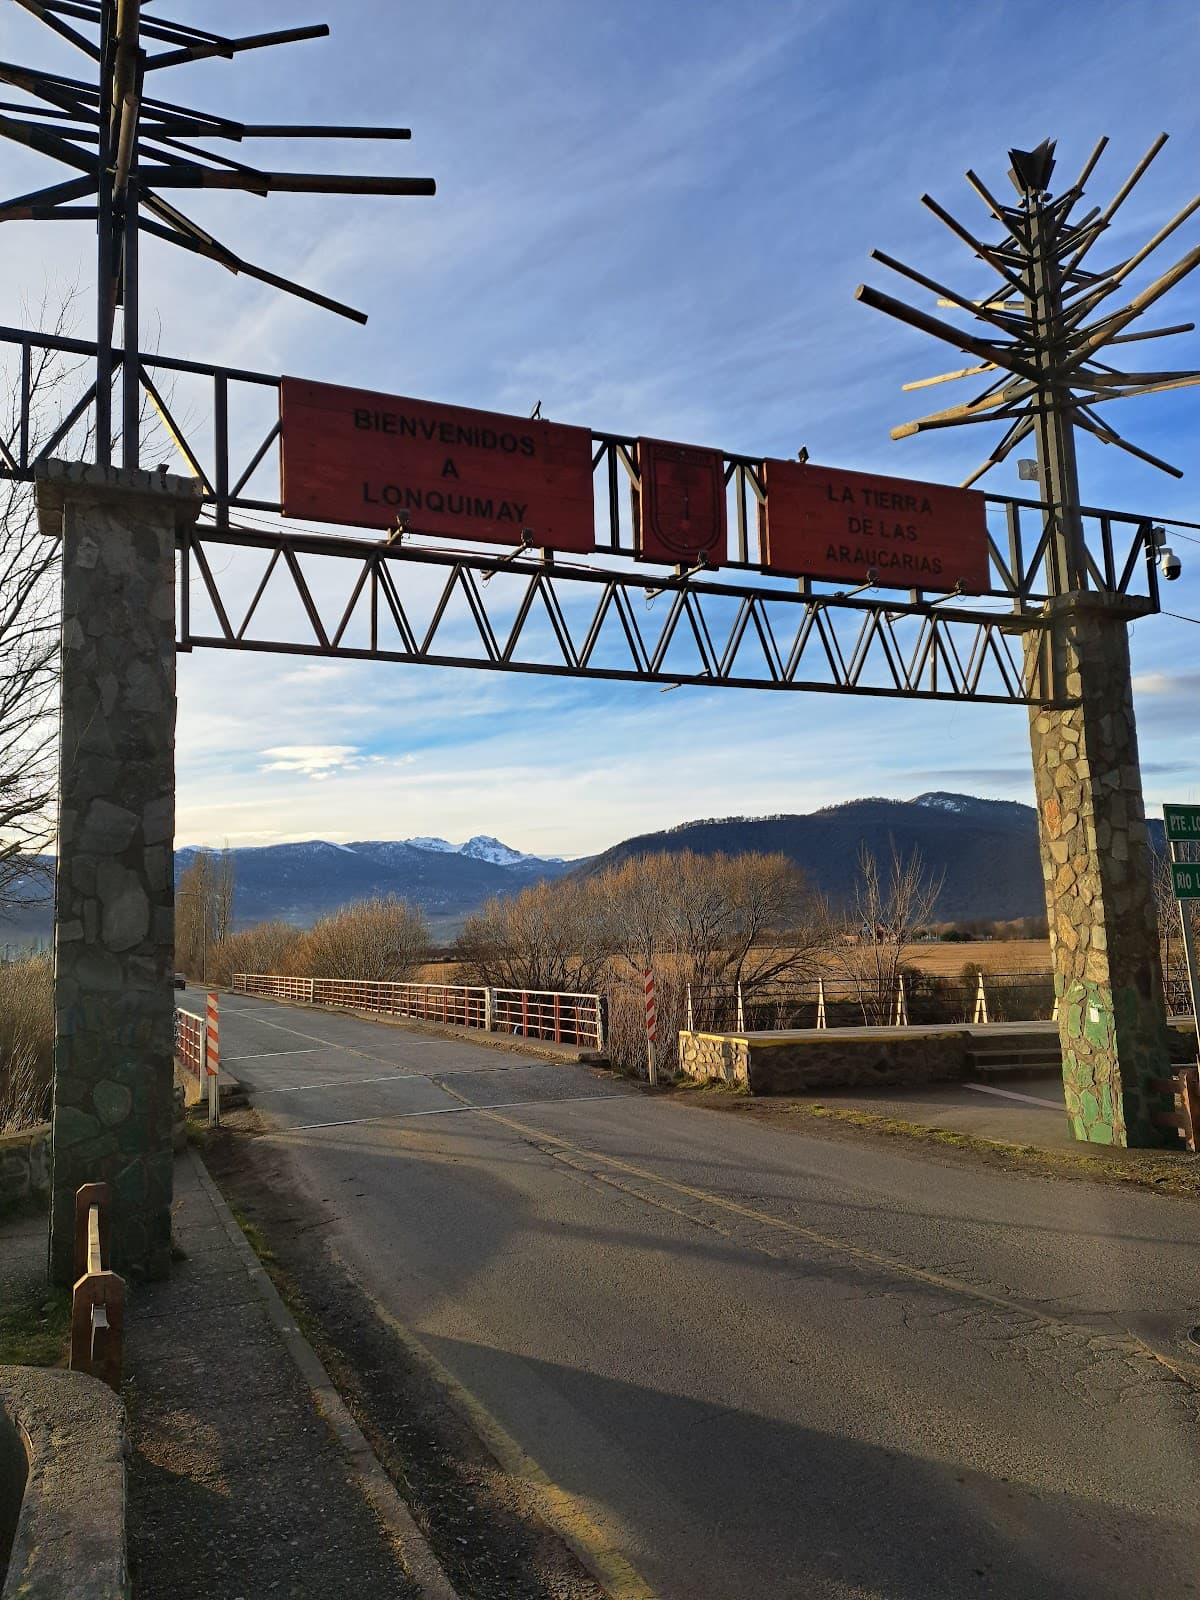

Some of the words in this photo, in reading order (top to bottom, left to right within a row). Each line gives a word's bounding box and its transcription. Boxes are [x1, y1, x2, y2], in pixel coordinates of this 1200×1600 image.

[354, 409, 535, 456] BIENVENIDOS
[441, 458, 459, 479] A
[362, 482, 528, 523] LONQUIMAY
[827, 484, 855, 504] LA
[861, 488, 932, 515] TIERRA
[848, 517, 874, 536] DE
[880, 521, 917, 542] LAS
[826, 543, 942, 575] ARAUCARIAS
